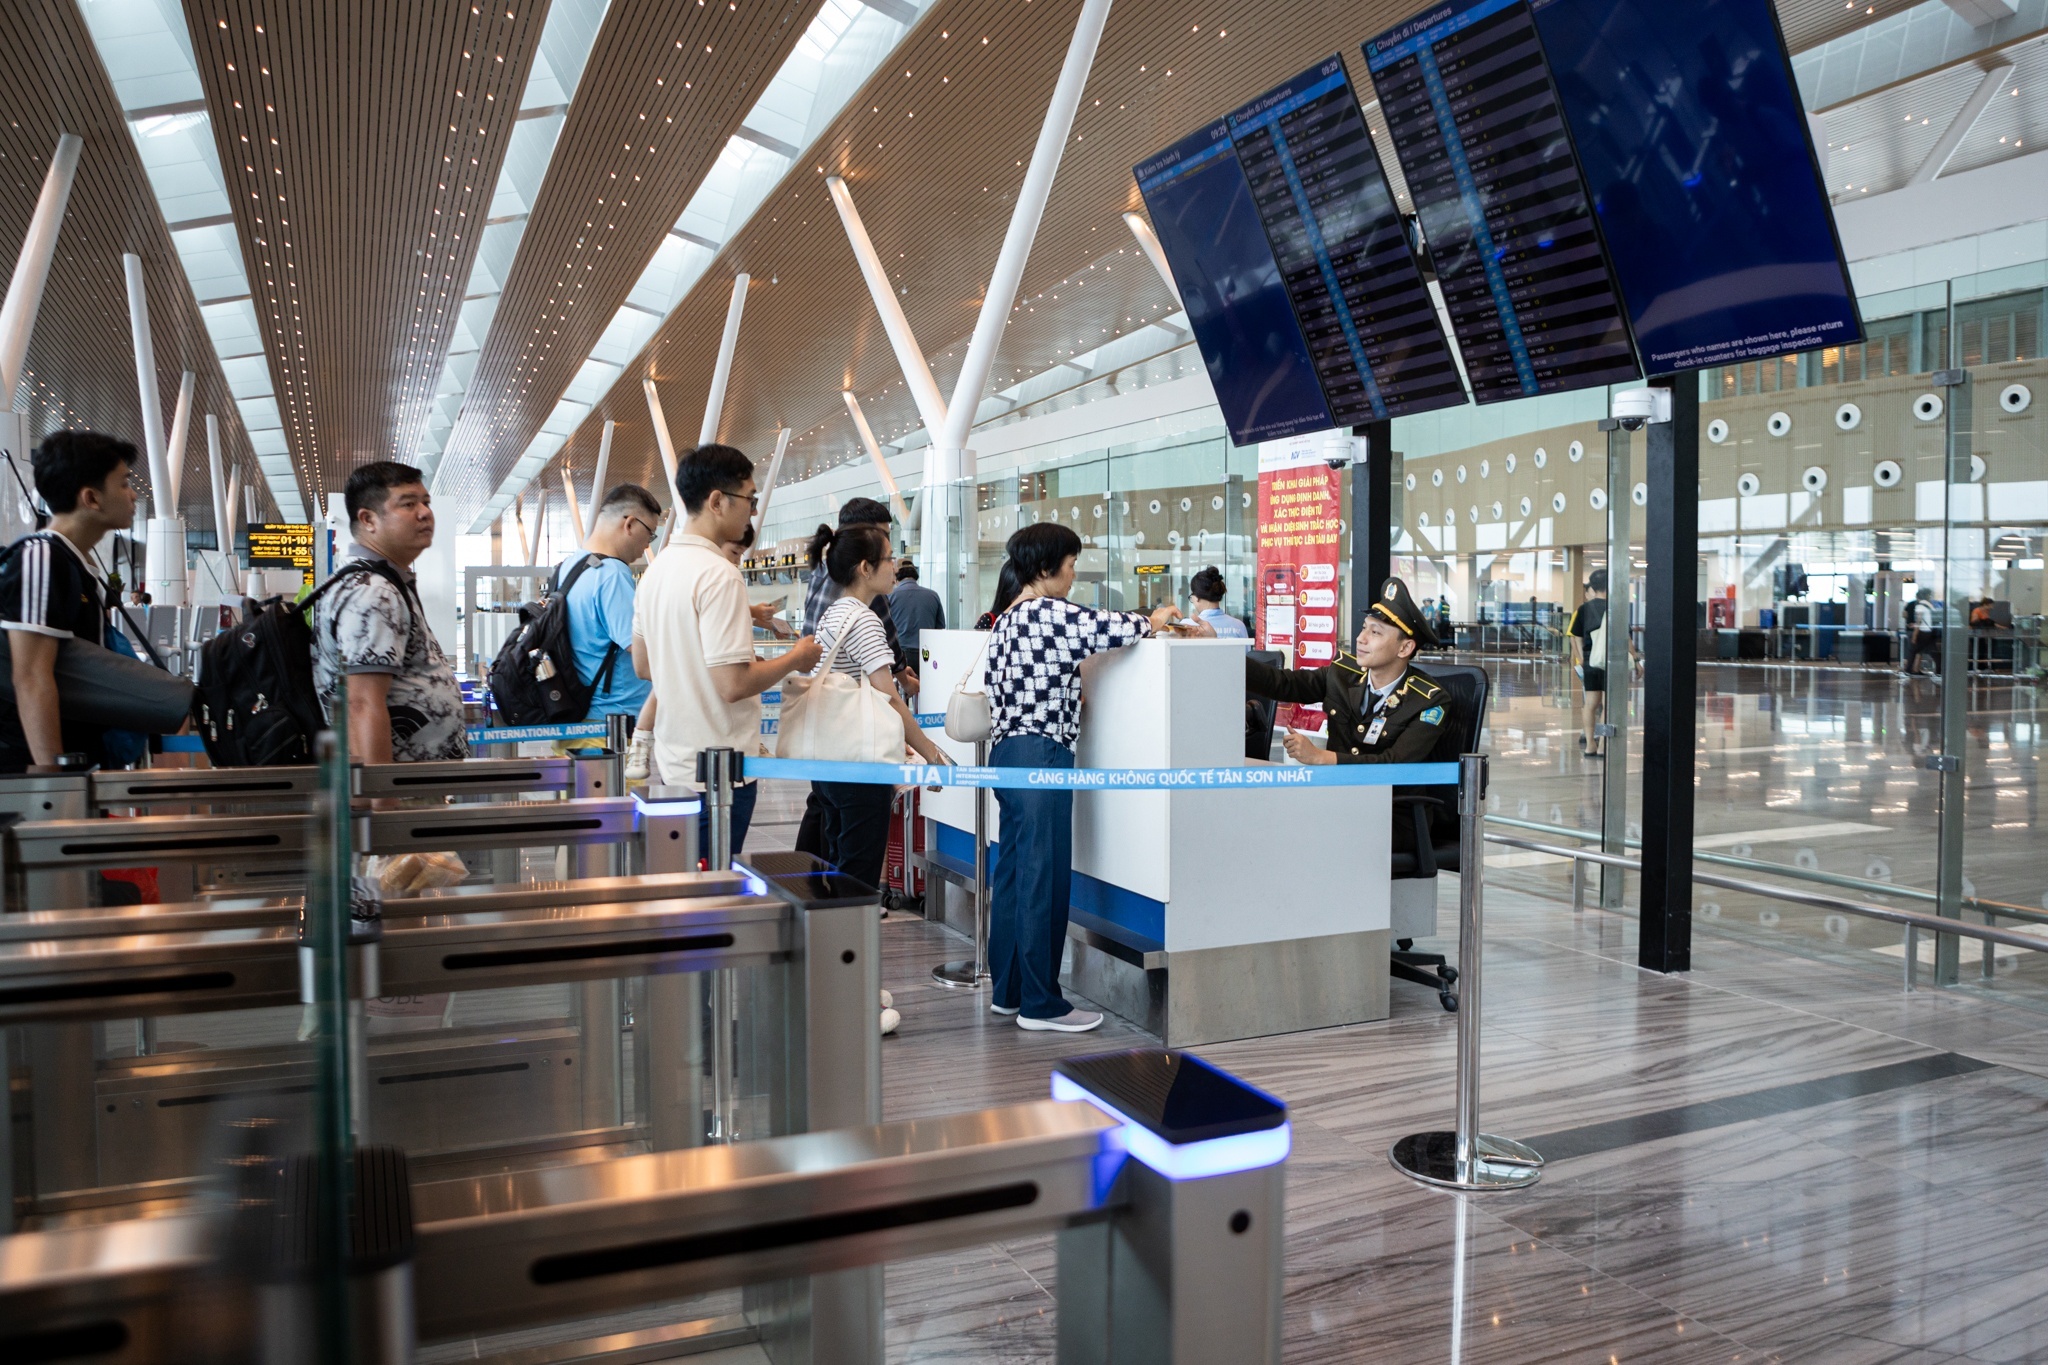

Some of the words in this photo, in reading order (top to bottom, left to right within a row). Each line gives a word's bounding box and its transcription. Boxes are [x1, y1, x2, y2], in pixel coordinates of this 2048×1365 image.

[1376, 30, 1401, 51] Chuyến
[1401, 26, 1409, 38] đi
[1413, 7, 1452, 32] Departures
[1321, 61, 1338, 75] 09:29
[1235, 106, 1254, 124] Chuyến
[1263, 88, 1292, 108] Departures
[1651, 348, 1691, 361] Passengers
[1691, 346, 1706, 354] who
[1707, 342, 1730, 352] names
[1731, 339, 1744, 347] are
[1744, 334, 1769, 345] shown
[1769, 330, 1790, 341] here,
[1790, 327, 1817, 337] please
[1818, 321, 1843, 331] return
[1674, 357, 1703, 368] check-in
[1704, 352, 1735, 363] counters
[1735, 349, 1747, 357] for
[1748, 343, 1780, 356] baggage
[1781, 336, 1822, 350] inspection
[1287, 479, 1297, 489] KHAI
[1298, 476, 1312, 488] GIẢI
[1313, 474, 1328, 486] PHÁP
[1281, 494, 1296, 505] DỤNG
[1297, 492, 1312, 504] ĐỊNH
[1274, 507, 1287, 518] XÁC
[1301, 505, 1315, 517] ĐIỆN
[1316, 503, 1322, 515] TỬ
[1261, 523, 1268, 533] VÀ
[1295, 521, 1308, 531] SINH
[1310, 517, 1324, 530] TRẮC
[1325, 519, 1338, 530] HỌC
[281, 536, 307, 545] 01-10
[1274, 537, 1282, 548] VỤ
[1305, 534, 1315, 545] LÊN
[1326, 534, 1337, 544] BAY
[282, 546, 307, 555] 11-55
[484, 727, 563, 740] INTERNATIONAL
[566, 724, 606, 736] AIRPORT
[761, 721, 778, 733] IA
[899, 765, 942, 784] TIA
[1028, 769, 1064, 785] CẢNG
[1068, 769, 1105, 785] HÀNG
[1109, 770, 1155, 785] KHÔNG
[1159, 769, 1196, 786] QUỐC
[1199, 768, 1214, 784] TẾ
[1217, 769, 1242, 784] TÂN
[1246, 769, 1273, 783] SƠN
[1277, 767, 1313, 782] NHẤT
